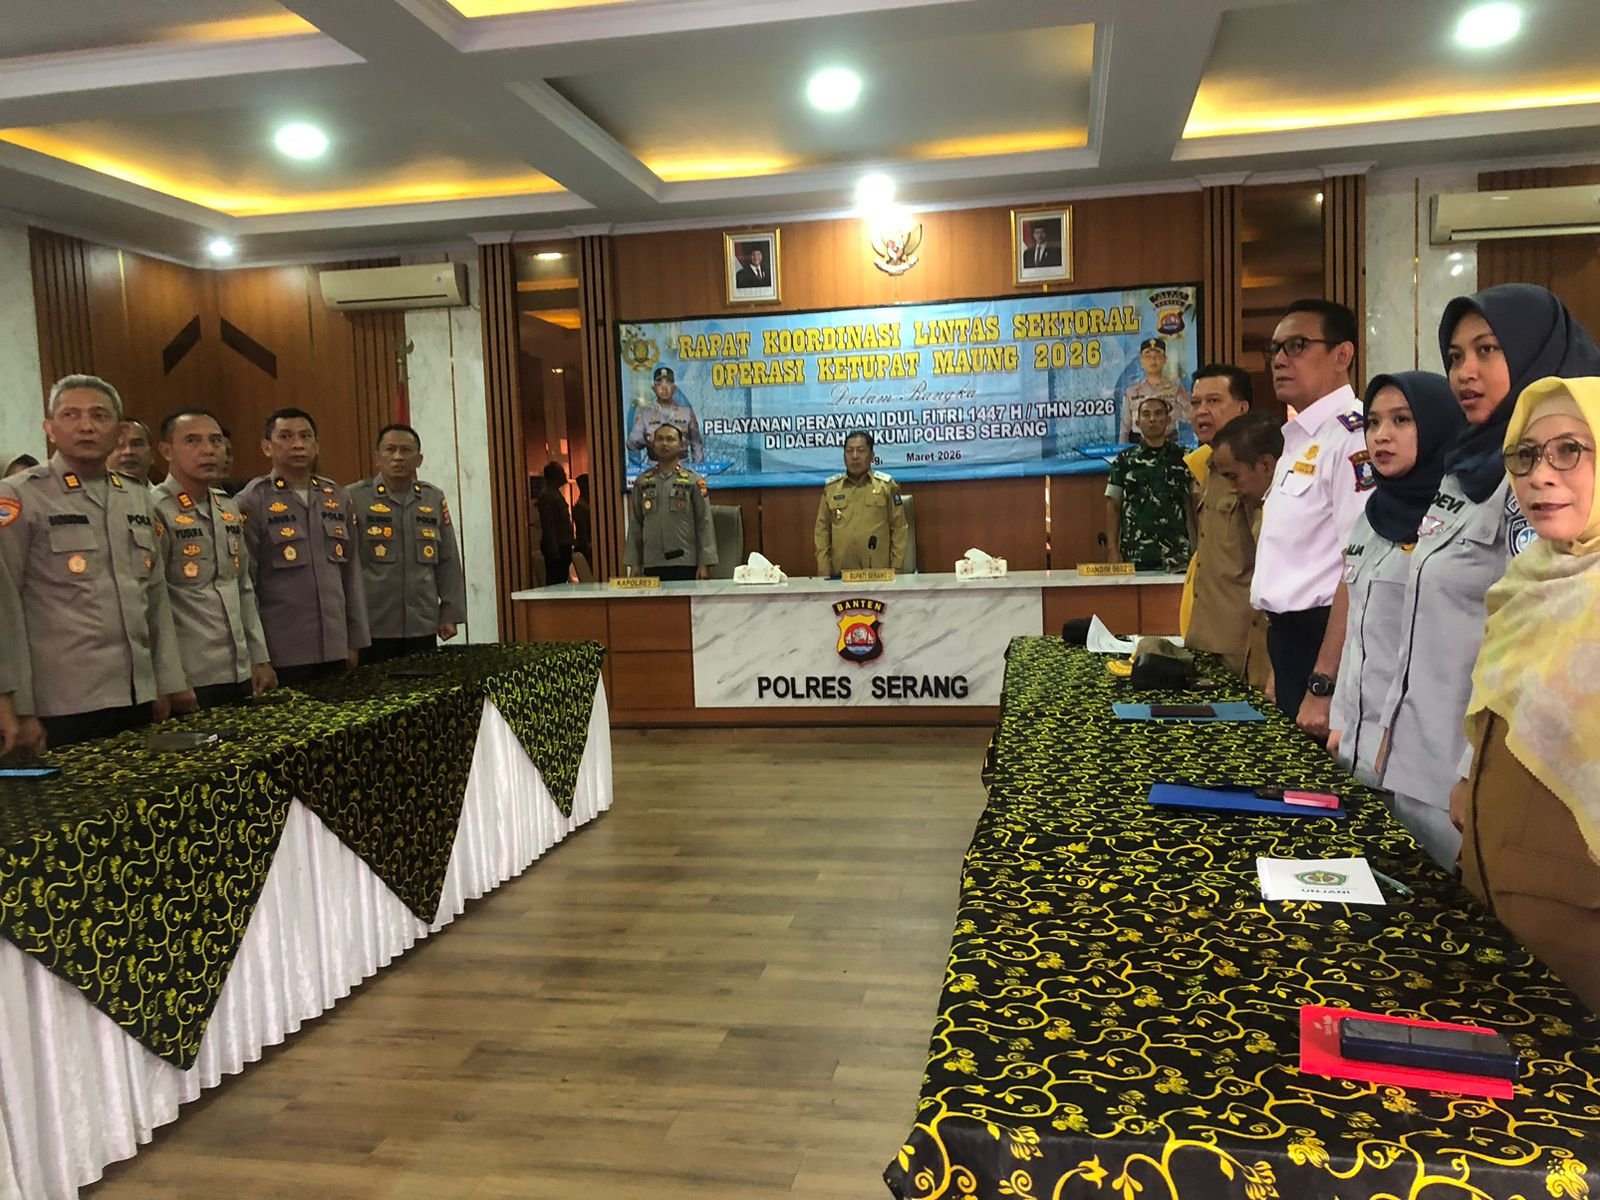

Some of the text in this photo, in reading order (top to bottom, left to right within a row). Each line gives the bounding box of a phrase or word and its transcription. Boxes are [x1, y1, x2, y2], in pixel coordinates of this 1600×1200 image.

[678, 306, 1140, 360] RAPAT KOORDINASI LINTAS SEKTORAL
[712, 340, 1102, 388] OPERASI KETUPAT MAUNG 2026
[827, 380, 977, 405] Dalam Rangka
[704, 416, 793, 435] PELAYANAN
[796, 412, 877, 431] PERAYAAN
[881, 409, 919, 428] IDUL
[921, 406, 964, 426] FITRI
[968, 403, 1005, 423] 1447
[1010, 402, 1023, 420] H
[1036, 401, 1073, 419] THN
[1075, 399, 1115, 418] 2026
[765, 434, 781, 450] DI
[785, 429, 847, 449] DAERAH
[913, 423, 975, 443] POLRES
[980, 420, 1048, 439] SERANG
[906, 450, 962, 462] Maret 2026
[836, 599, 882, 612] BANTEN
[758, 675, 969, 699] POLRES SERANG
